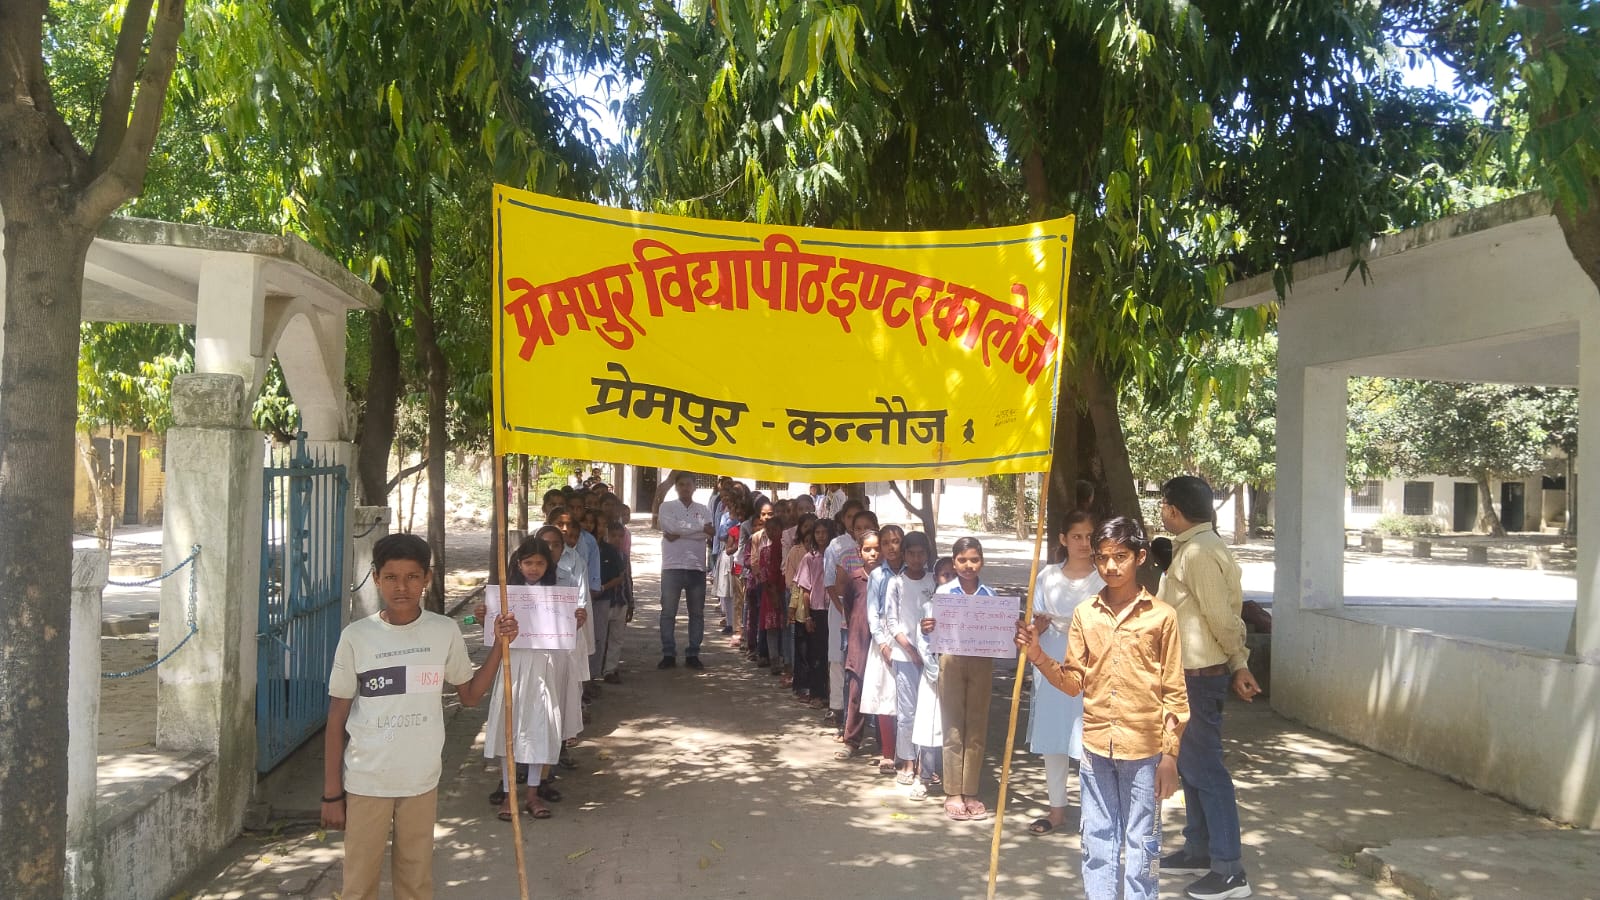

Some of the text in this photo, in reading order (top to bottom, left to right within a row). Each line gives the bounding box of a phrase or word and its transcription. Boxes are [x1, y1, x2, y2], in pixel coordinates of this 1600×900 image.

[505, 264, 646, 362] प्रेमपुर
[633, 235, 838, 317] विद्यापीठ
[825, 258, 944, 348] इण्टर
[586, 362, 749, 447] प्रेमपुर
[786, 396, 947, 446] कन्नौज
[421, 671, 439, 686] USA
[377, 713, 422, 729] LACOSTE
